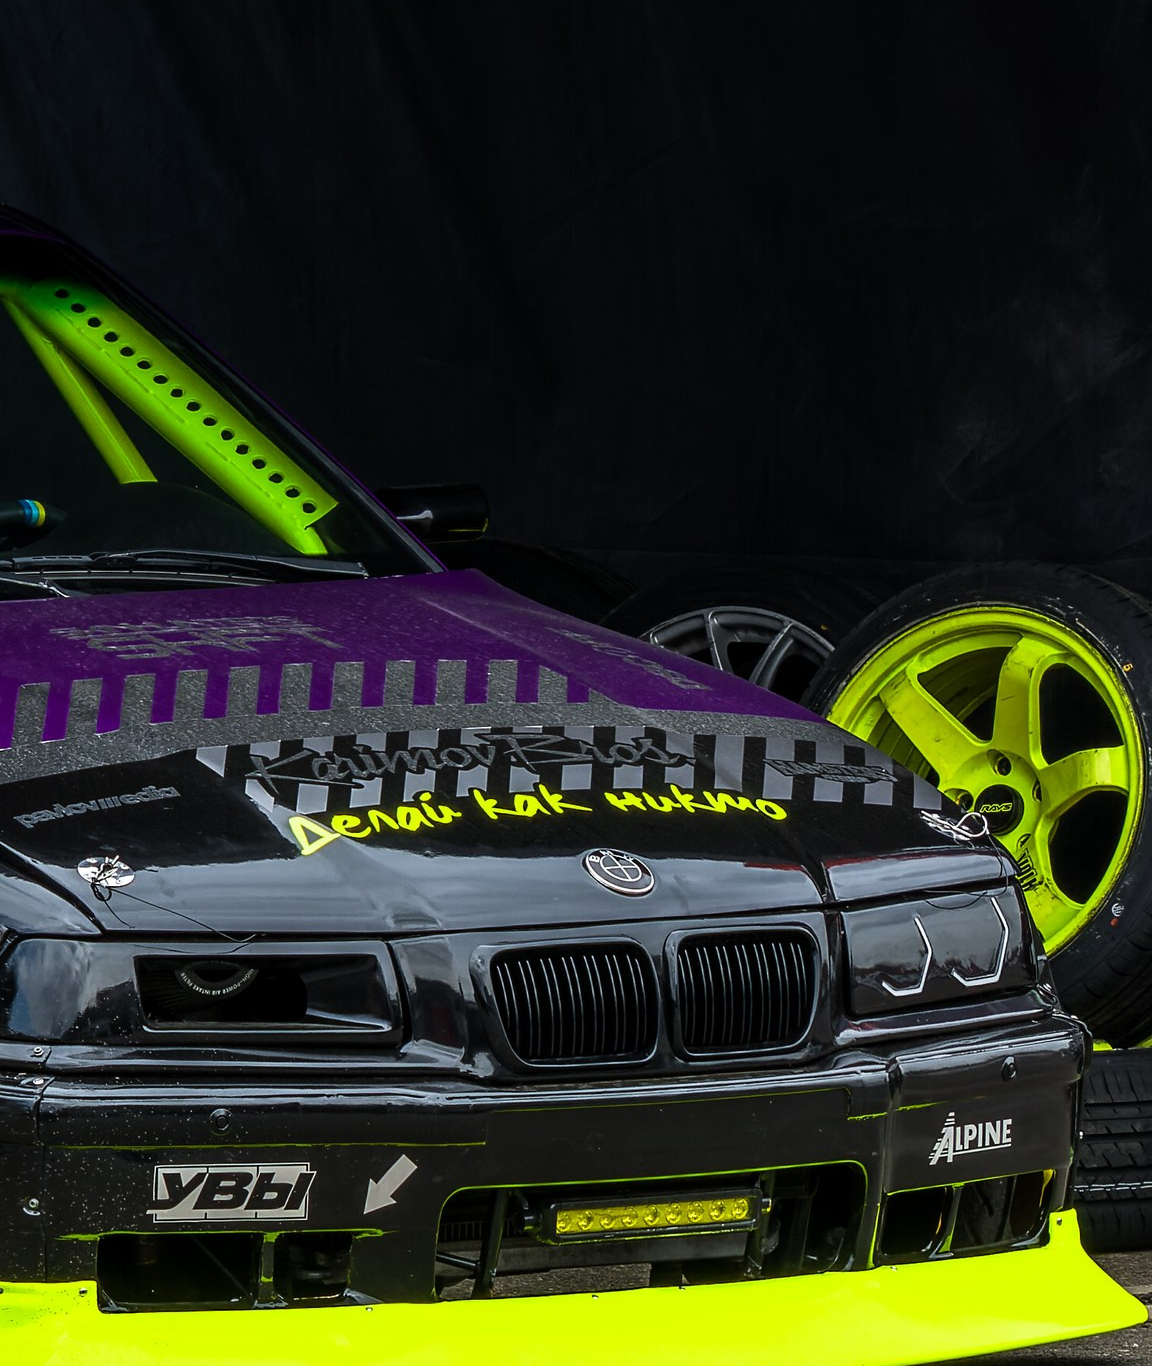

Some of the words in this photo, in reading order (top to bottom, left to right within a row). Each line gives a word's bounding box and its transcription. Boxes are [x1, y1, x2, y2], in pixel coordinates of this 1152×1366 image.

[244, 744, 496, 795] Karimov
[980, 802, 1013, 813] RAYS
[928, 1112, 1012, 1165] ALPINE
[146, 1171, 316, 1212] УВЫ
